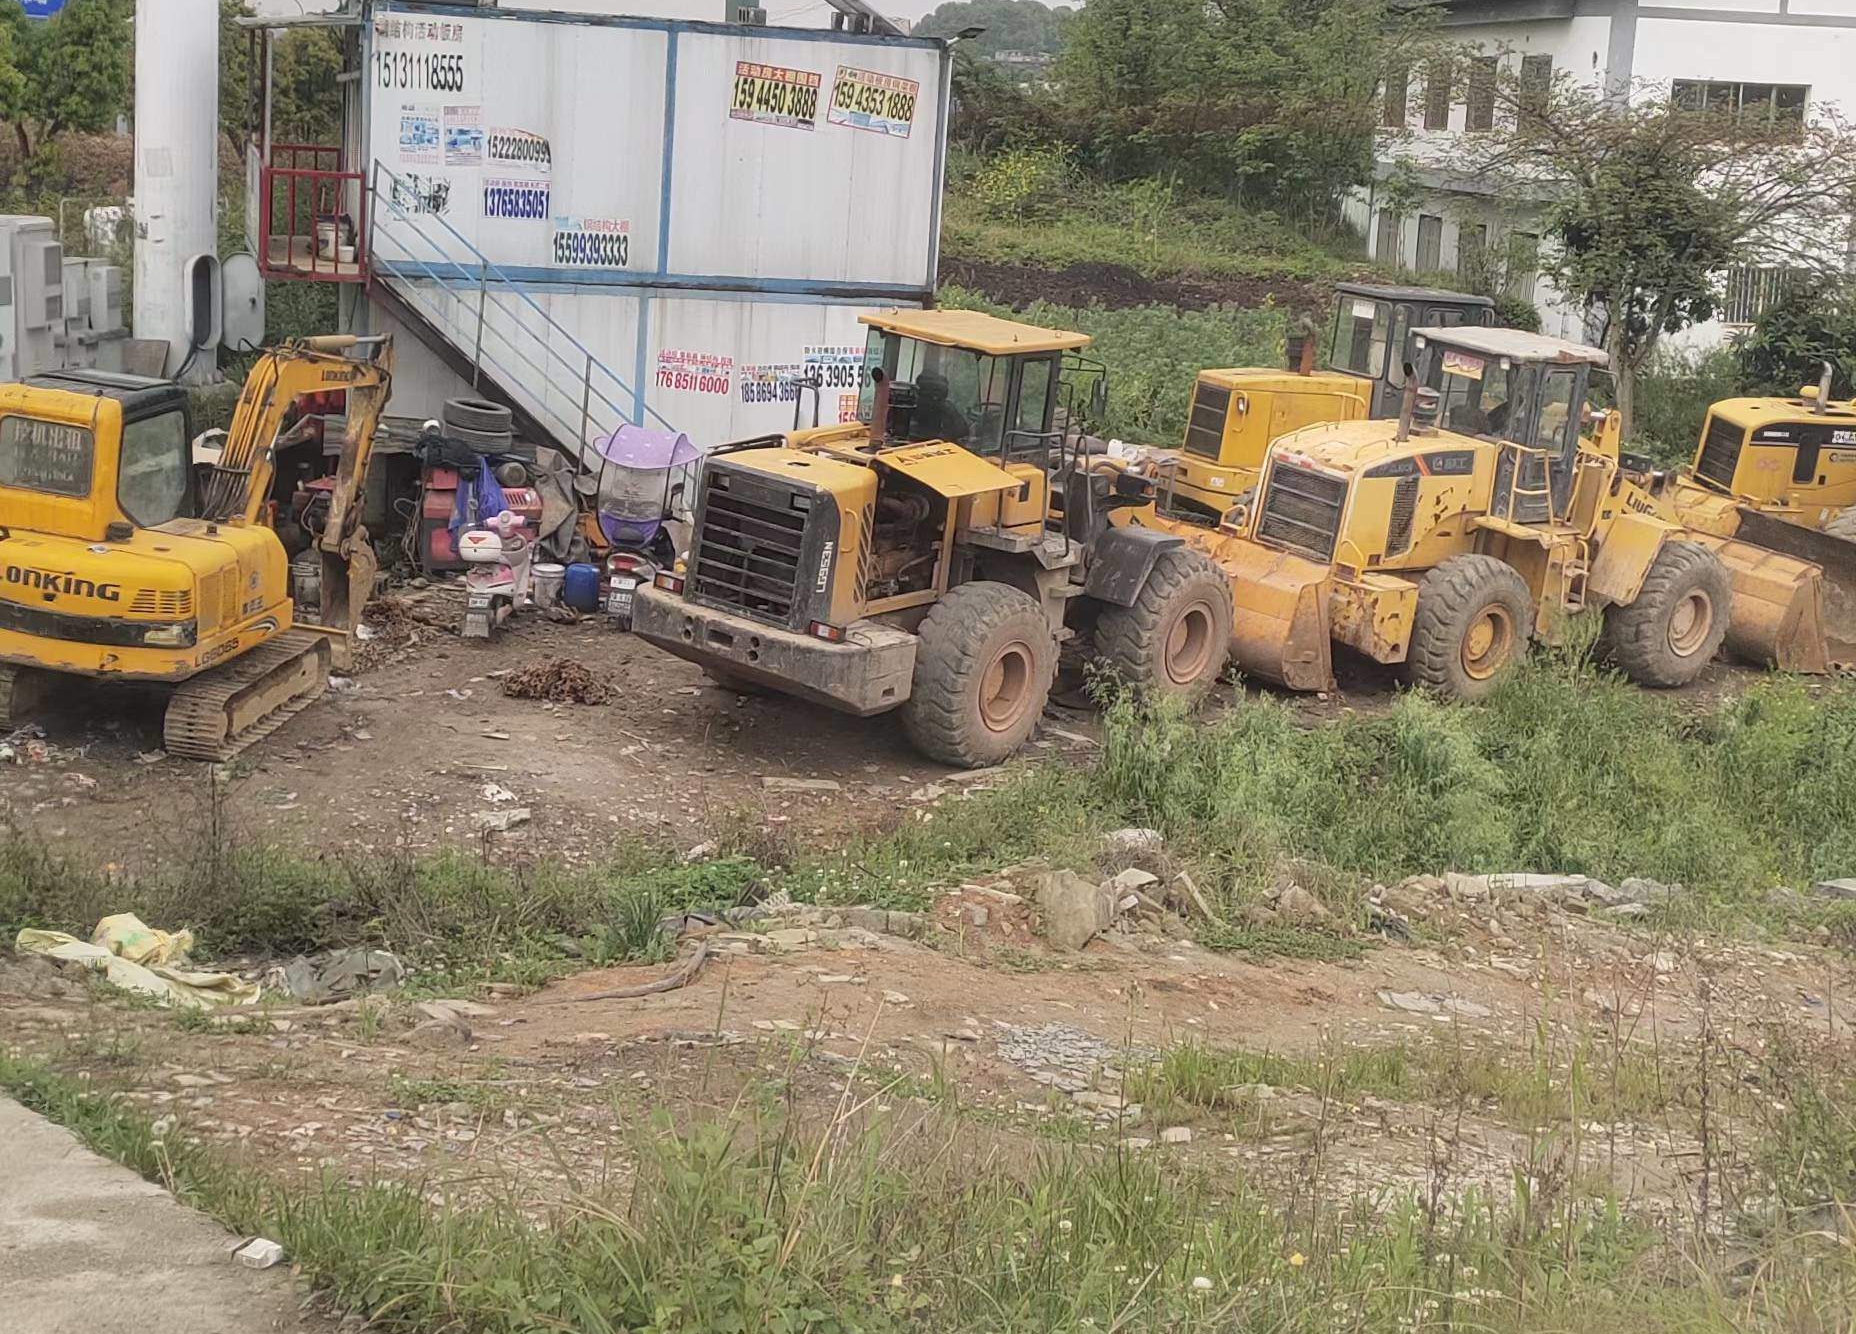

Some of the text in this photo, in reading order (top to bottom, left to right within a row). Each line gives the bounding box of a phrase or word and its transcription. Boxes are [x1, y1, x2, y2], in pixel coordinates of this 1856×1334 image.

[376, 52, 463, 92] 15131118555
[734, 76, 755, 109] 159
[756, 80, 786, 115] 4450
[787, 85, 818, 119] 3888
[834, 80, 914, 122] 159 4353 1888
[484, 187, 550, 220] 13765835051
[553, 231, 628, 266] 15599393333
[656, 370, 728, 395] 176 8511 6000
[741, 382, 755, 403] 185
[756, 381, 777, 402] 8694
[826, 365, 854, 387] 3905
